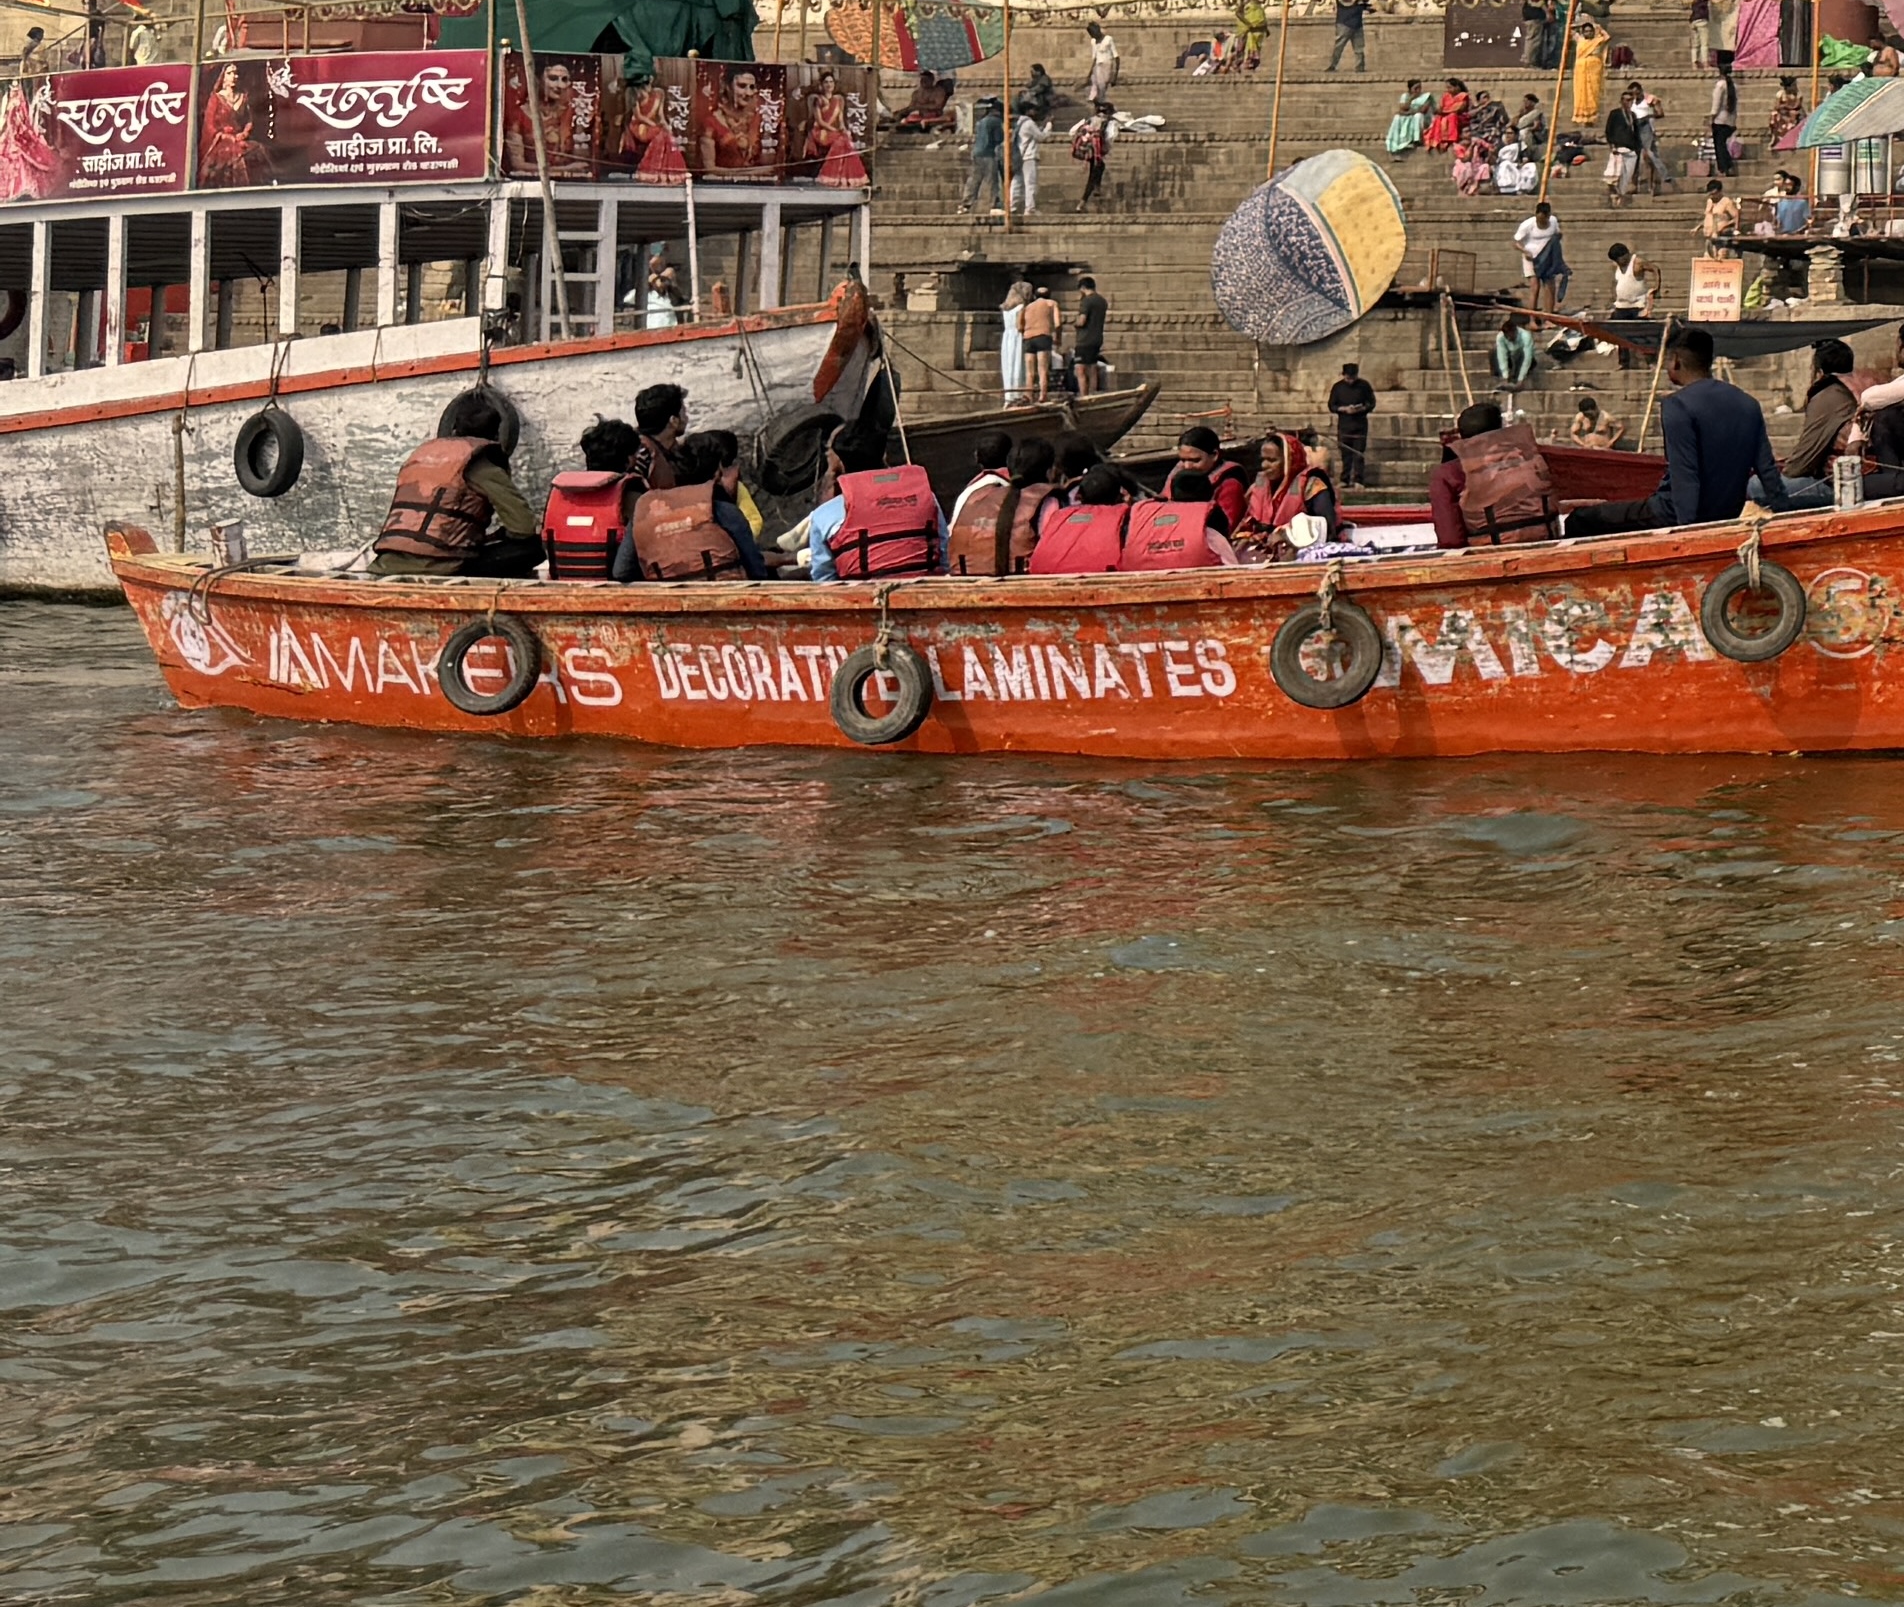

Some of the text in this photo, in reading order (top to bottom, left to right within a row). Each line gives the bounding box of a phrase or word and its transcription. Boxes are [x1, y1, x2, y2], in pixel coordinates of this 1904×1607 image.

[57, 81, 187, 145] सन्तुष्टि
[296, 67, 473, 129] सन्तुष्टि
[324, 130, 443, 160] साड़ीज प्रा. लि.
[646, 640, 902, 703] DECORATIE
[923, 638, 1238, 702] LAMINATES
